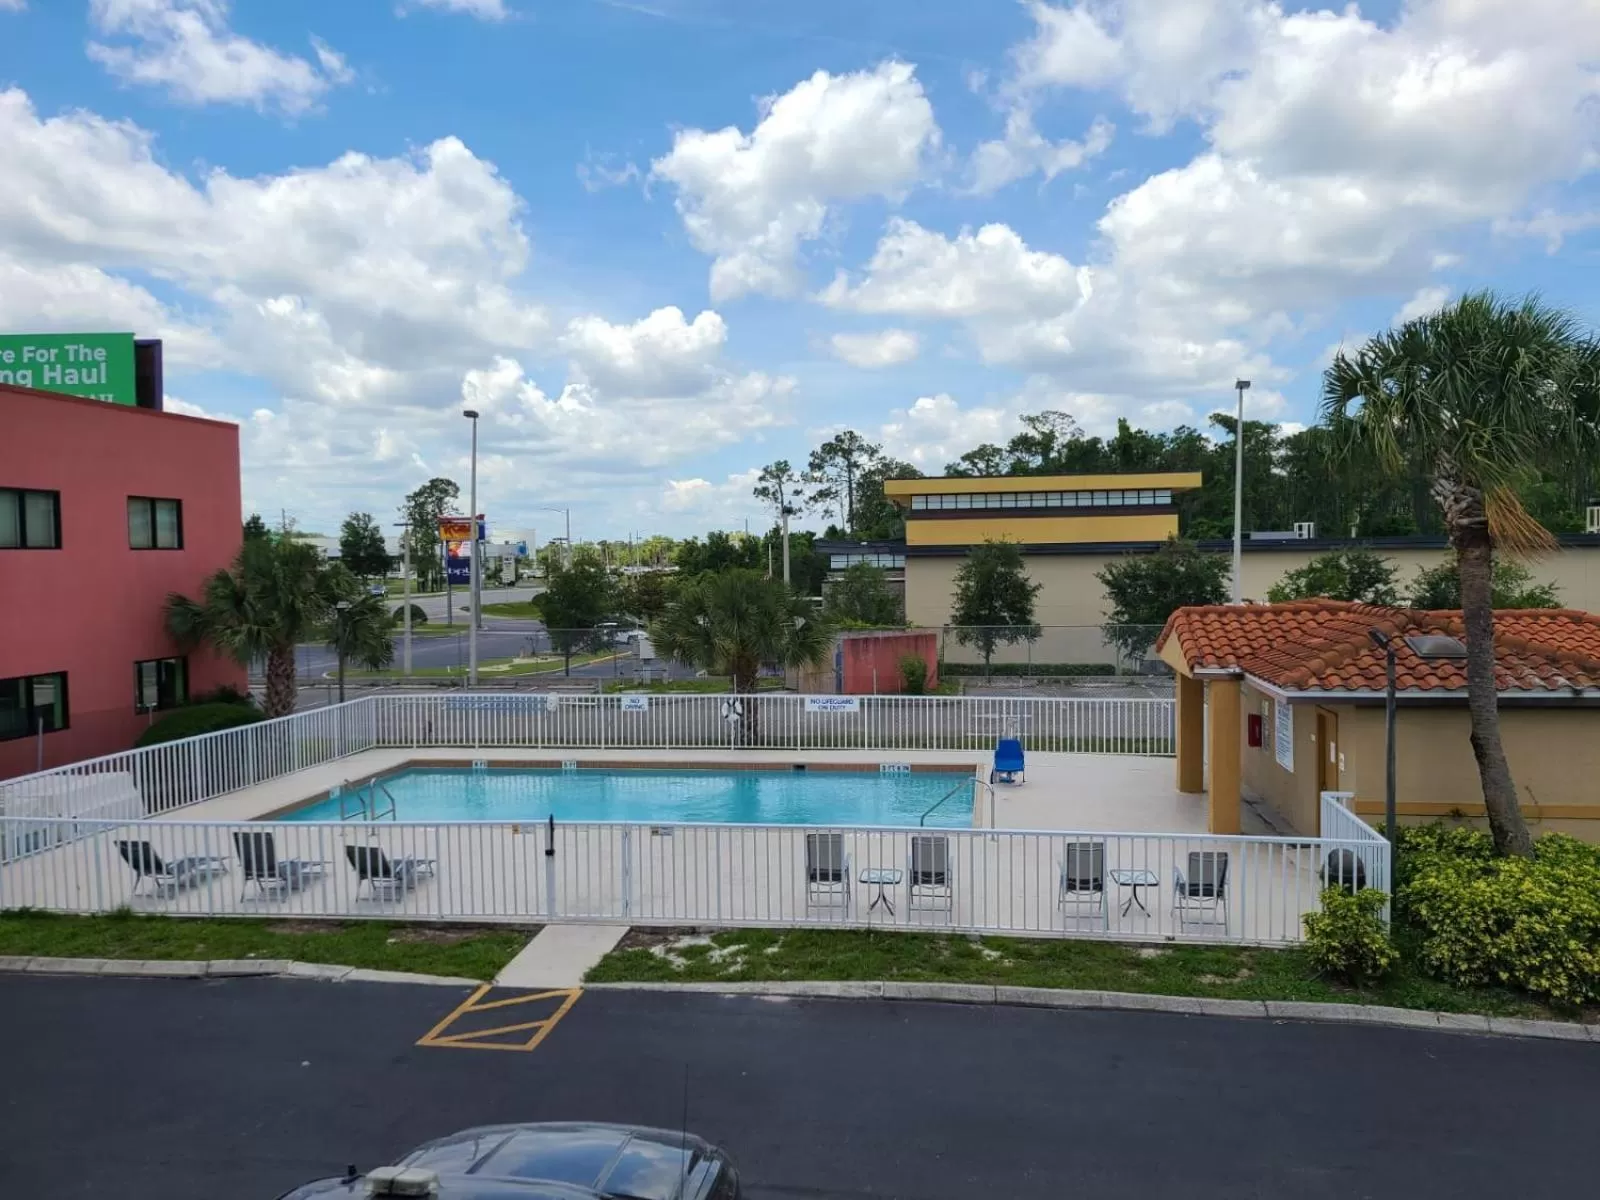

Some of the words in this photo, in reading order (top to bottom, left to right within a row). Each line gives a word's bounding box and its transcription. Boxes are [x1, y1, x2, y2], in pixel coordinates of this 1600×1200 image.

[22, 346, 59, 363] For
[64, 343, 107, 362] The
[43, 363, 107, 385] Haul
